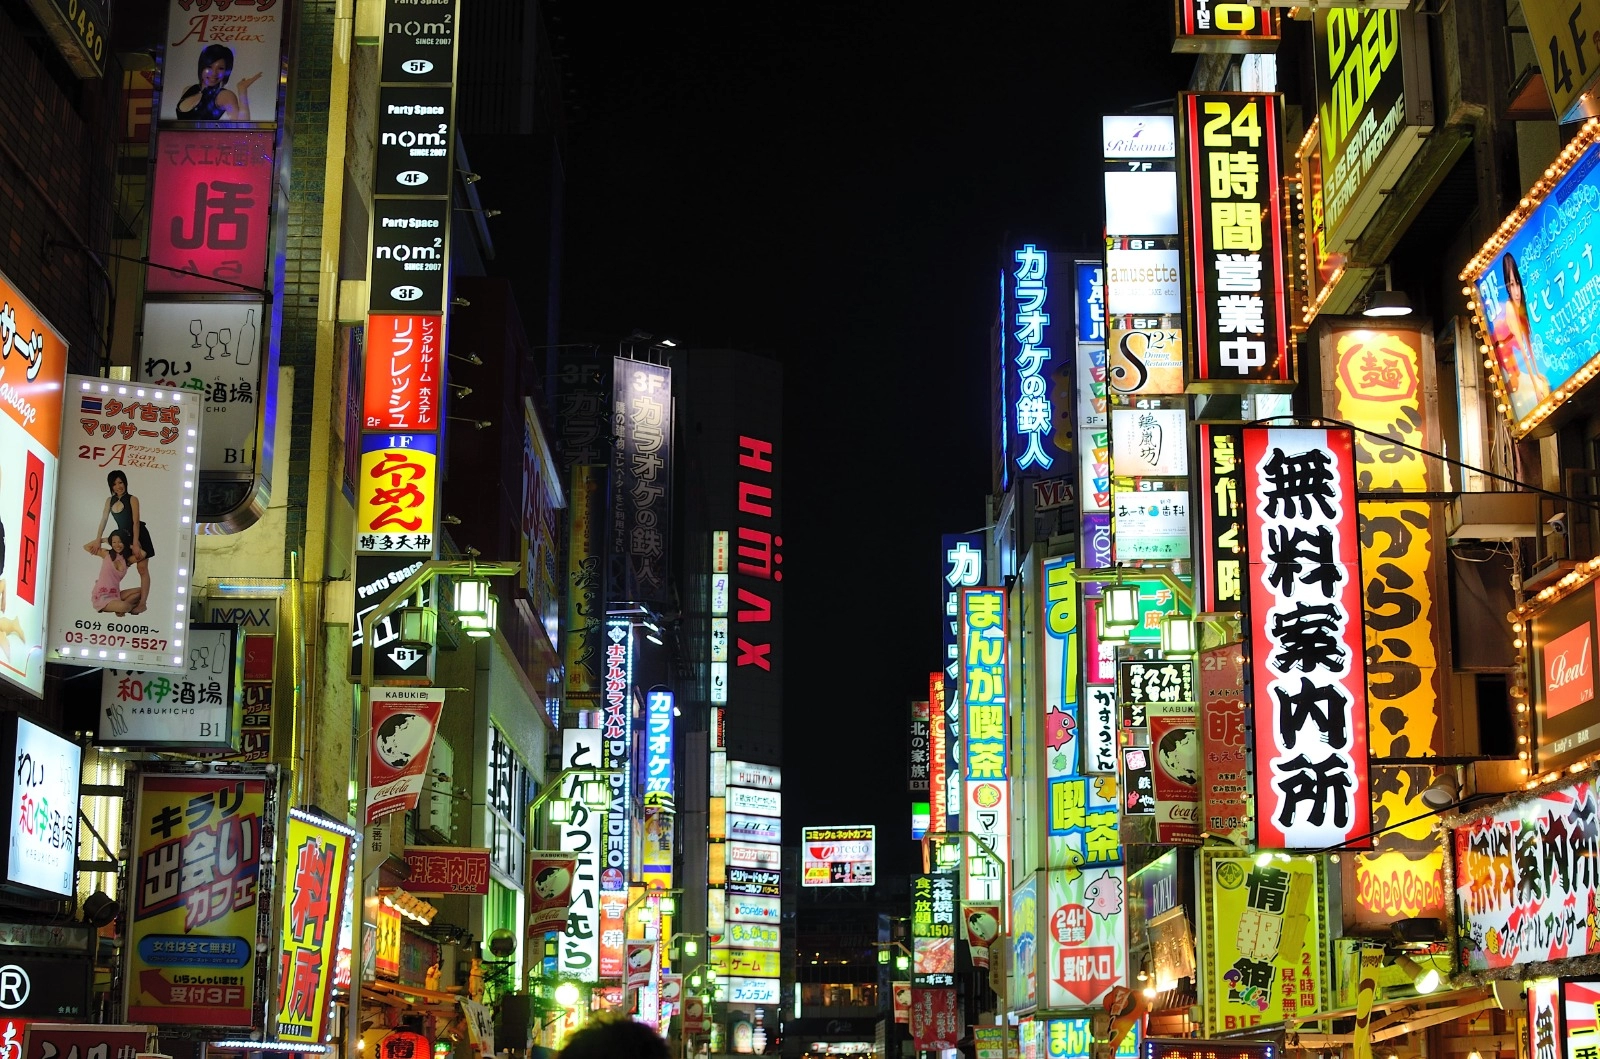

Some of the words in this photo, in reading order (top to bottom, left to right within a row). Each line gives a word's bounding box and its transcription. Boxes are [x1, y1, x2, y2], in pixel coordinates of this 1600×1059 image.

[1549, 2, 1587, 94] 4F
[410, 62, 426, 72] 5F
[388, 105, 413, 115] Party
[415, 105, 444, 115] Space
[1346, 107, 1377, 172] RENTAL
[1361, 92, 1404, 177] MAGAZINE
[1128, 162, 1152, 171] 7F
[404, 174, 420, 183] 4F
[382, 218, 408, 228] Party
[409, 218, 439, 228] Space
[1131, 240, 1154, 249] 6F
[1203, 102, 1266, 375] 24時間営業中
[404, 263, 424, 271] SINCE
[425, 263, 442, 271] 2007
[1111, 263, 1177, 283] amusette
[399, 289, 415, 298] 3F
[1134, 319, 1158, 328] 5F
[418, 318, 433, 382] レンタルルーム
[1013, 244, 1054, 470] カラオケの鉄人
[388, 318, 413, 428] リフレッシュ
[632, 371, 664, 392] 3F
[0, 365, 37, 427] assage
[417, 387, 431, 424] ホステル
[1137, 400, 1161, 409] 4F
[104, 398, 180, 425] タイ古式
[367, 417, 381, 426] 2F
[80, 418, 179, 444] マッサージ
[388, 436, 413, 448] 1F
[78, 445, 105, 460] 2F
[224, 448, 246, 464] B1
[1139, 482, 1163, 491] 3F
[360, 535, 431, 550] 博多天神
[358, 577, 389, 599] Party
[75, 619, 102, 631] 60分
[65, 631, 168, 651] 03-3207-5527
[1263, 448, 1352, 828] 無料案内所
[397, 651, 416, 661] B1
[1204, 657, 1228, 671] 2F
[1549, 637, 1590, 690] Real
[117, 676, 223, 706] 和伊酒場
[605, 643, 627, 739] ホテルがライバル
[968, 593, 1004, 779] まんが喫茶
[199, 722, 220, 737] B1
[245, 716, 268, 725] 3F
[648, 691, 671, 776] カラオケ
[1554, 736, 1572, 753] Lady's
[1577, 729, 1589, 744] BAR
[911, 722, 926, 779] 北の家族
[646, 778, 671, 791] 747
[151, 782, 245, 840] キラリ
[144, 819, 252, 907] 出会い
[186, 877, 255, 931] カフェ
[915, 877, 931, 924] 食べ放題
[1152, 874, 1176, 917] ROYAL
[1056, 909, 1087, 929] 24H
[1058, 928, 1086, 942] 営業
[1500, 904, 1587, 957] ファイナルアンサー
[731, 958, 761, 971] ゲーム
[1063, 955, 1111, 982] 受付入口
[1299, 953, 1315, 1007] 24時間
[170, 986, 241, 1004] 受付3F
[734, 988, 773, 1000] フィンランド
